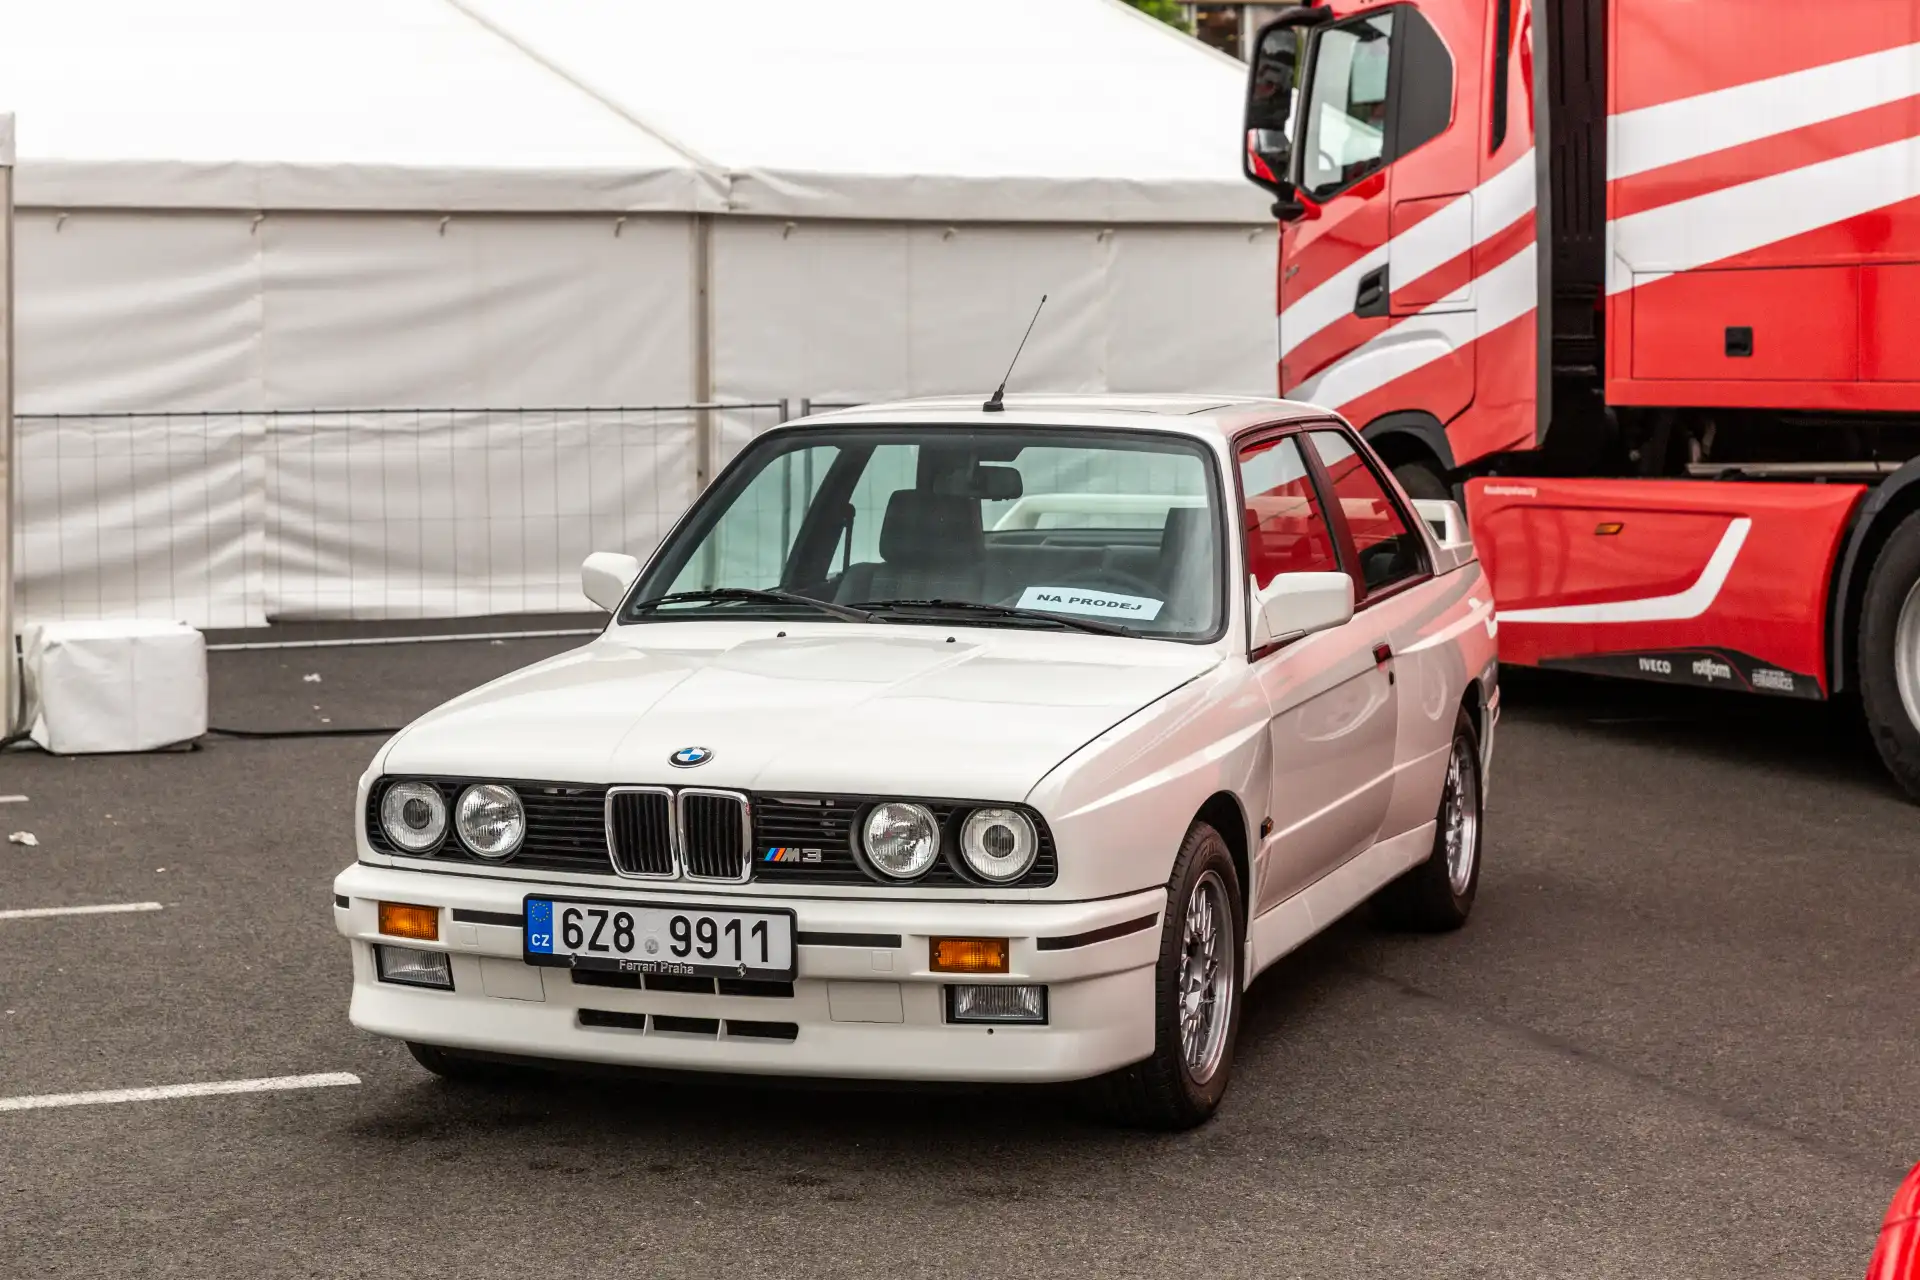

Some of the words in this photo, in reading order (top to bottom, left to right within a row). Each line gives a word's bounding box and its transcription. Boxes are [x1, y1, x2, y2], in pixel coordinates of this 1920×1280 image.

[1036, 594, 1062, 603] NA
[1068, 597, 1142, 611] PRODEJ
[1639, 657, 1671, 674] IVECO
[531, 933, 550, 947] CZ
[562, 907, 635, 953] 6Z8
[669, 914, 769, 963] 9911
[619, 959, 657, 972] Ferrari
[660, 961, 694, 975] Praha
